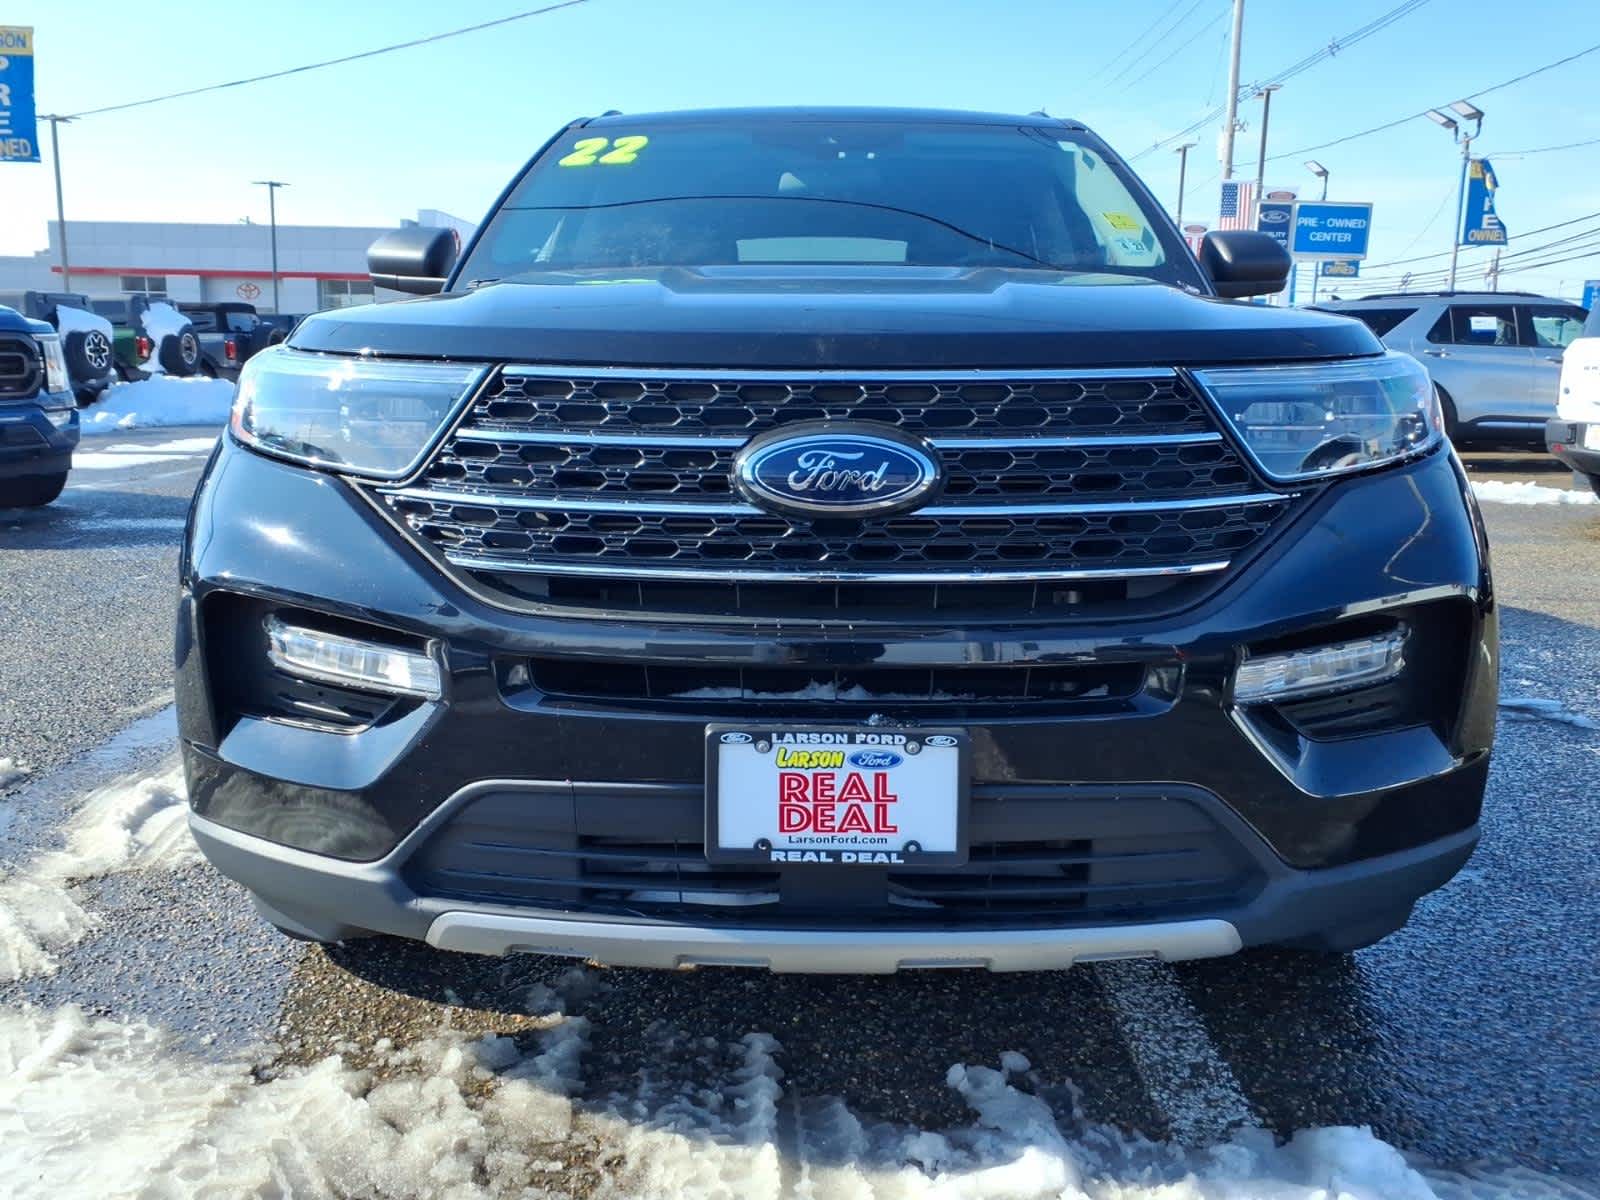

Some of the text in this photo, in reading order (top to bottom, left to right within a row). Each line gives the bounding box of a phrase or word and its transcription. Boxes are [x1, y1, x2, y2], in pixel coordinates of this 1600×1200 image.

[559, 135, 648, 167] 22
[1309, 231, 1352, 242] CENTER
[787, 450, 890, 492] Ford
[771, 732, 907, 745] LARSON FORD
[778, 772, 898, 803] REAL
[778, 803, 898, 833] DEAL
[787, 835, 888, 845] LarsonFord.com
[770, 851, 905, 864] REAL DEAL
